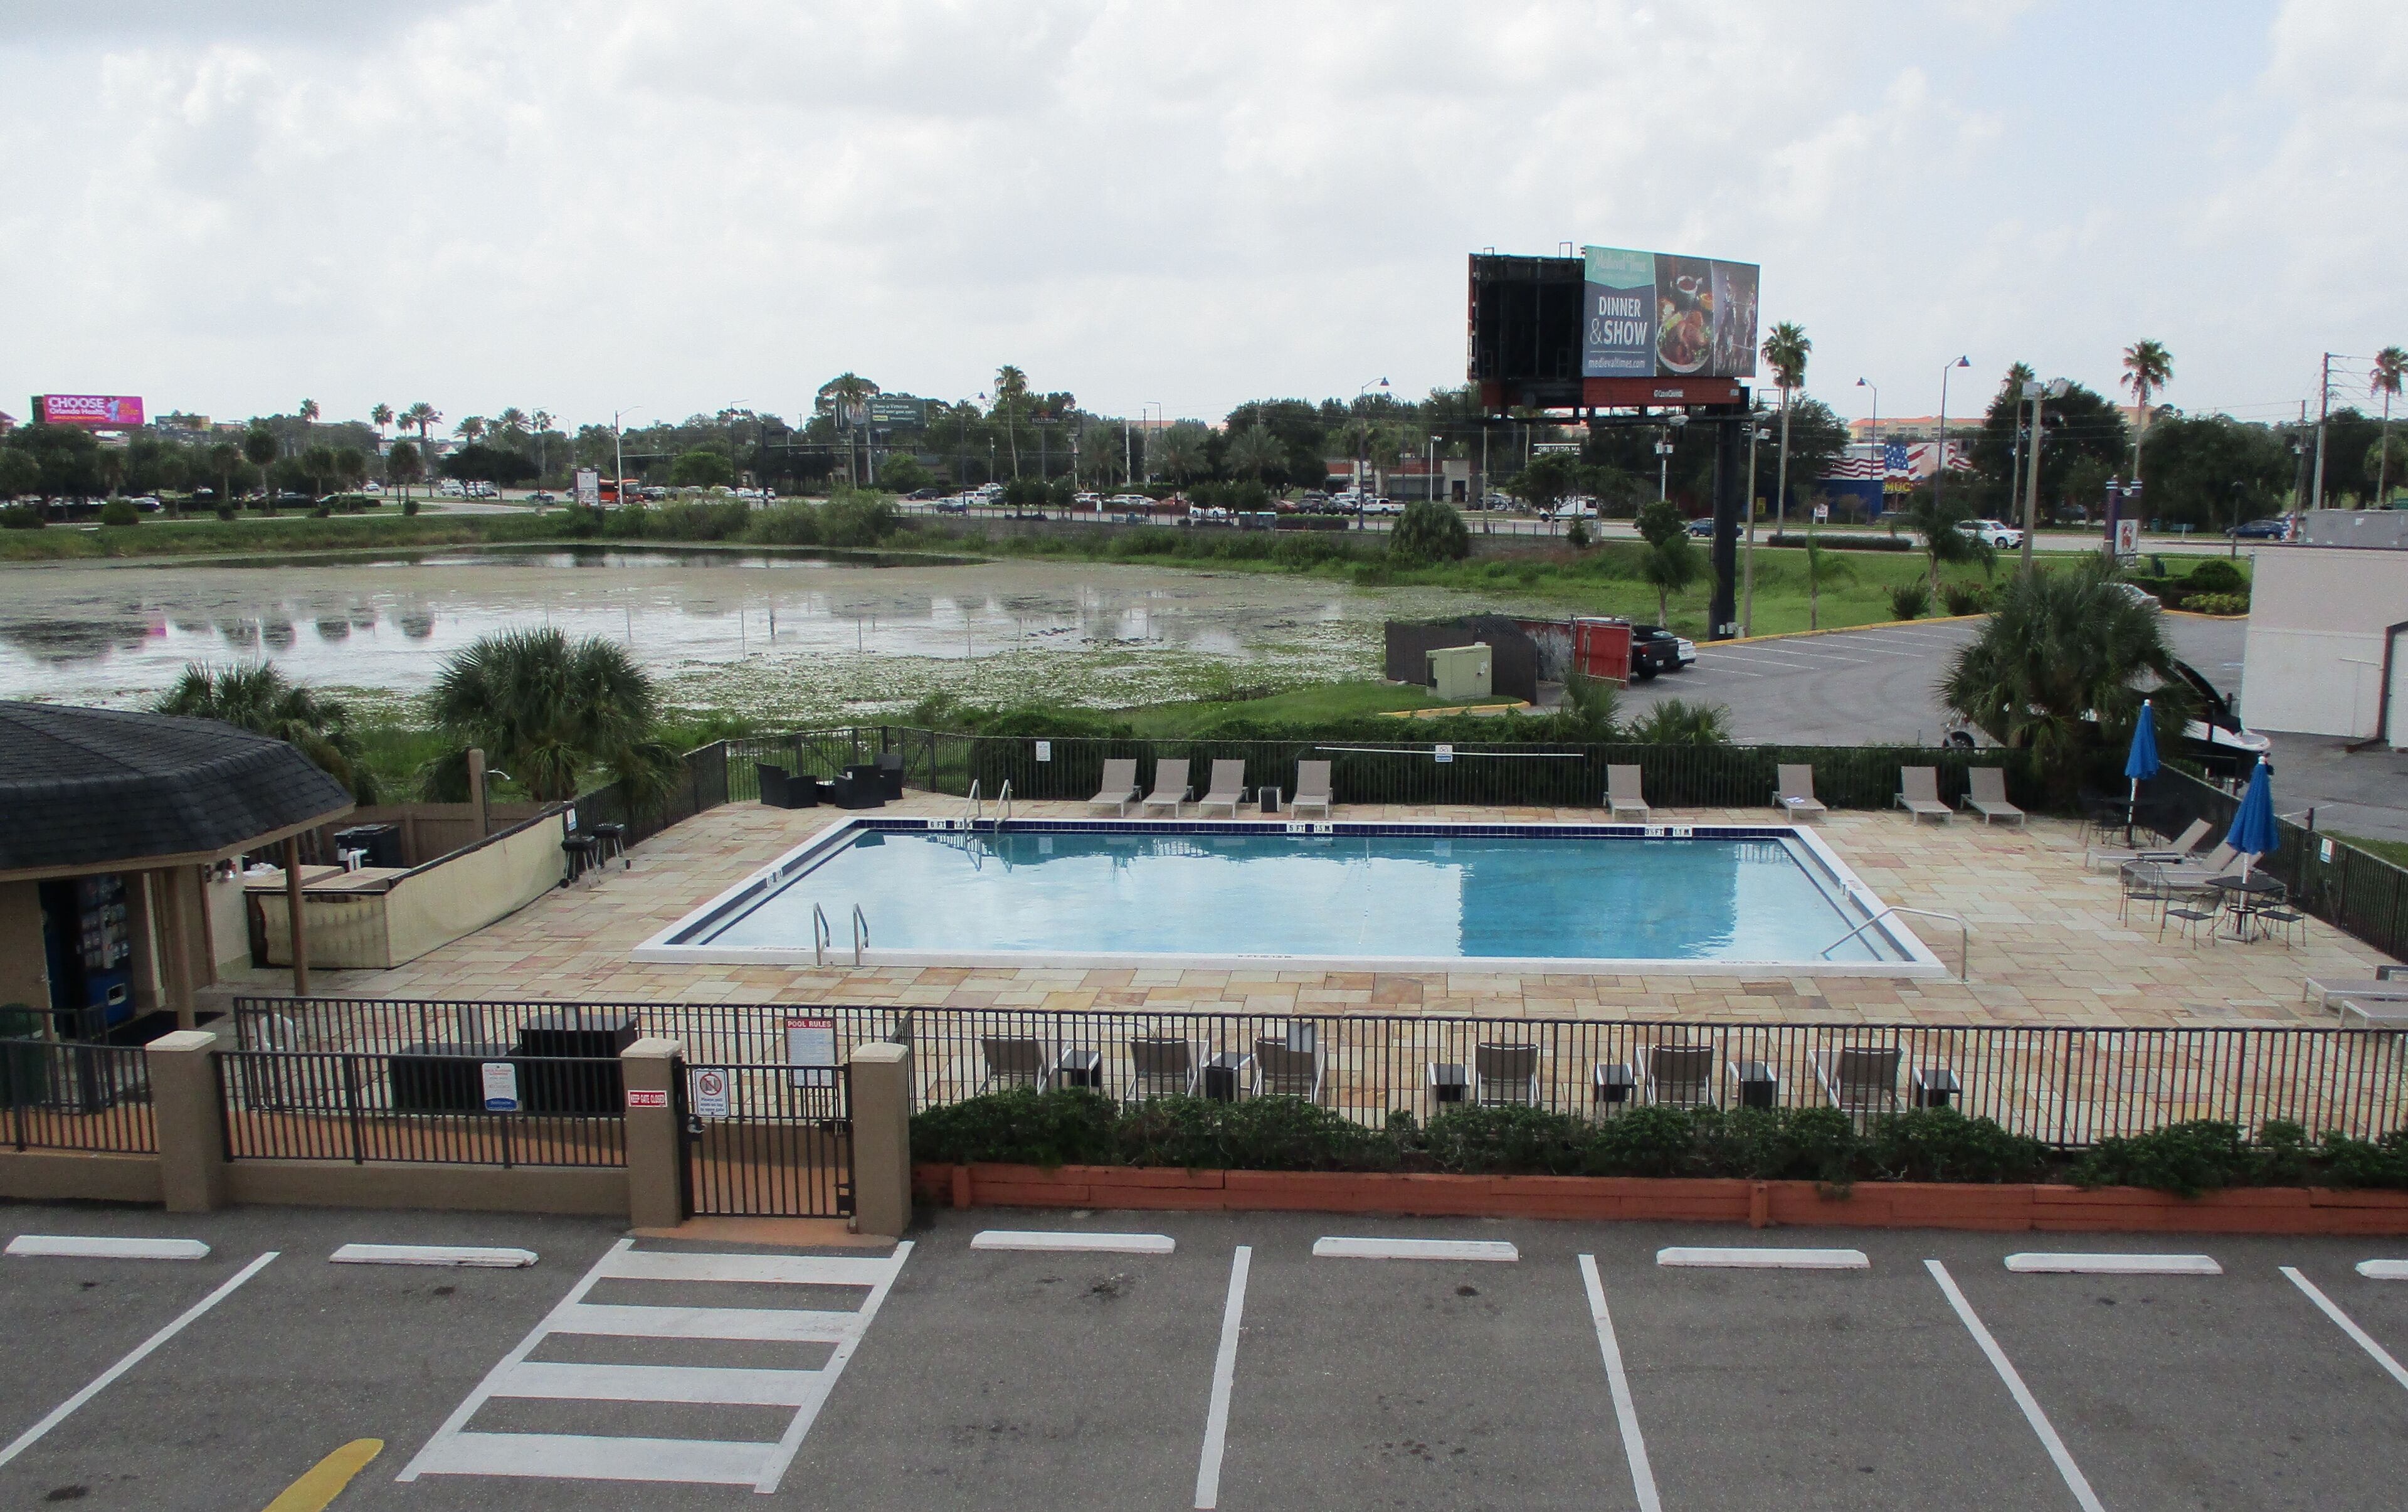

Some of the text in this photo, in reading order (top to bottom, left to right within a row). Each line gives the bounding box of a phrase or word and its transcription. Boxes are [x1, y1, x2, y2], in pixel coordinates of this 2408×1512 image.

[1598, 296, 1641, 317] DINNER
[1603, 320, 1648, 346] SHOW
[48, 397, 105, 408] CHOOSE
